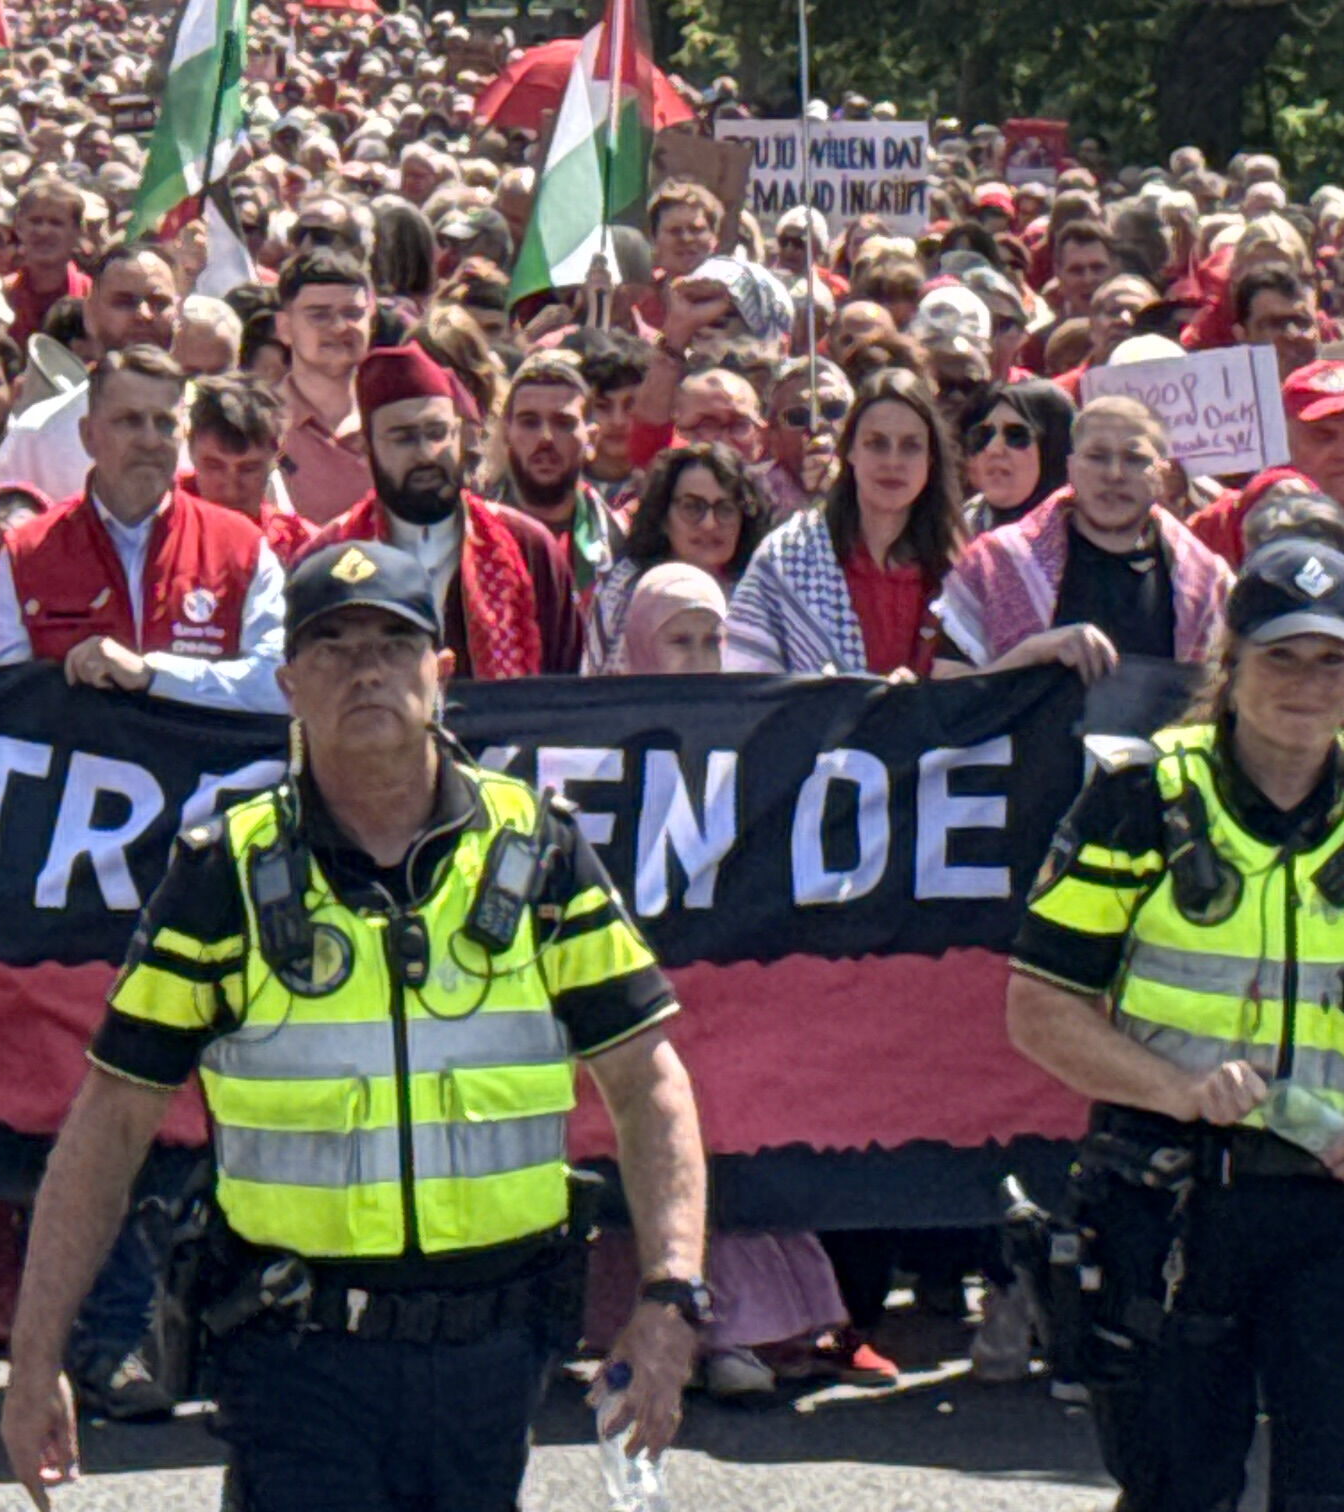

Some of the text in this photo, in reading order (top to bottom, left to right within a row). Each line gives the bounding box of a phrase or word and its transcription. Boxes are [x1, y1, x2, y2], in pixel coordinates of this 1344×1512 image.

[808, 130, 876, 170] WILLEN
[883, 135, 924, 170] DAT
[790, 734, 1014, 906] DE
